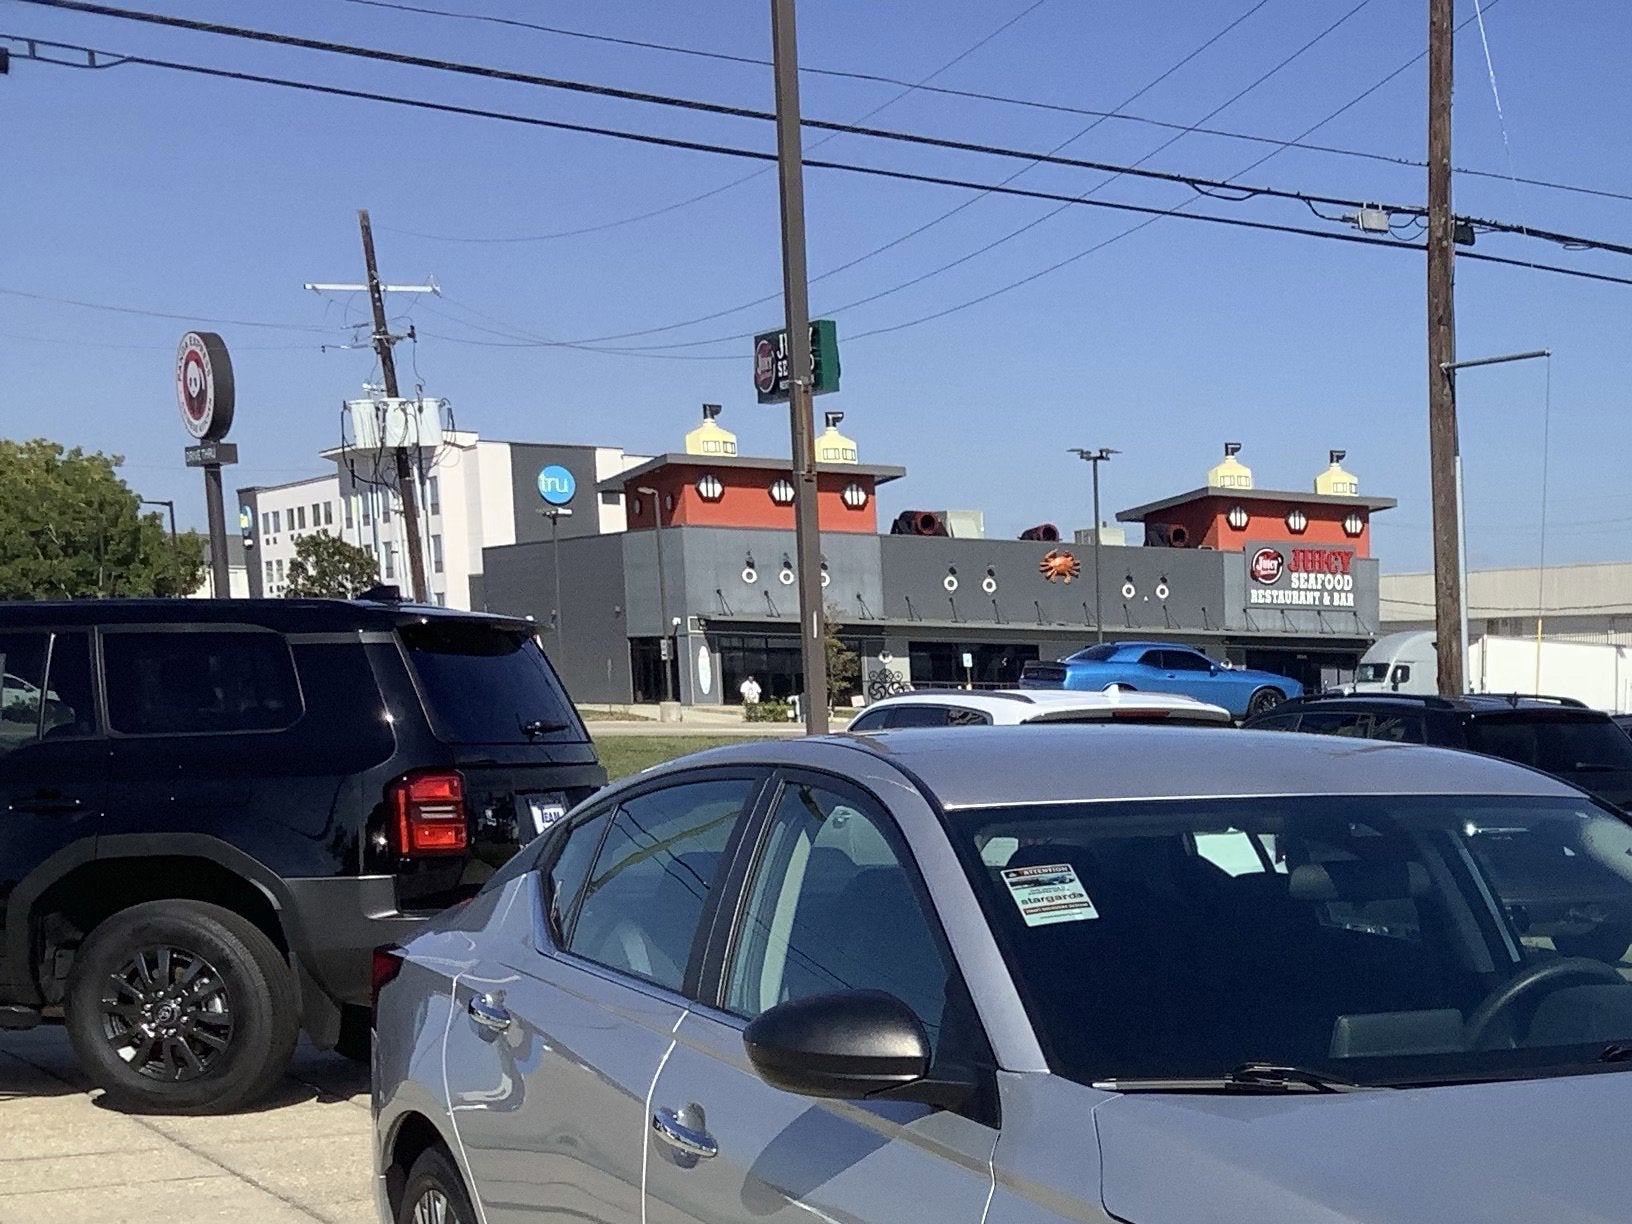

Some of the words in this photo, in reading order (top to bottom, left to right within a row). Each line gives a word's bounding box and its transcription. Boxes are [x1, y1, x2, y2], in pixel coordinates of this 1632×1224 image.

[538, 473, 569, 493] tru
[1287, 549, 1353, 574] JUICY
[1291, 573, 1353, 590] SEAFOOD
[1250, 589, 1320, 605] RESTAURANT
[1322, 592, 1330, 605] &
[1333, 592, 1354, 606] BAR
[1023, 866, 1069, 876] ATTENTION
